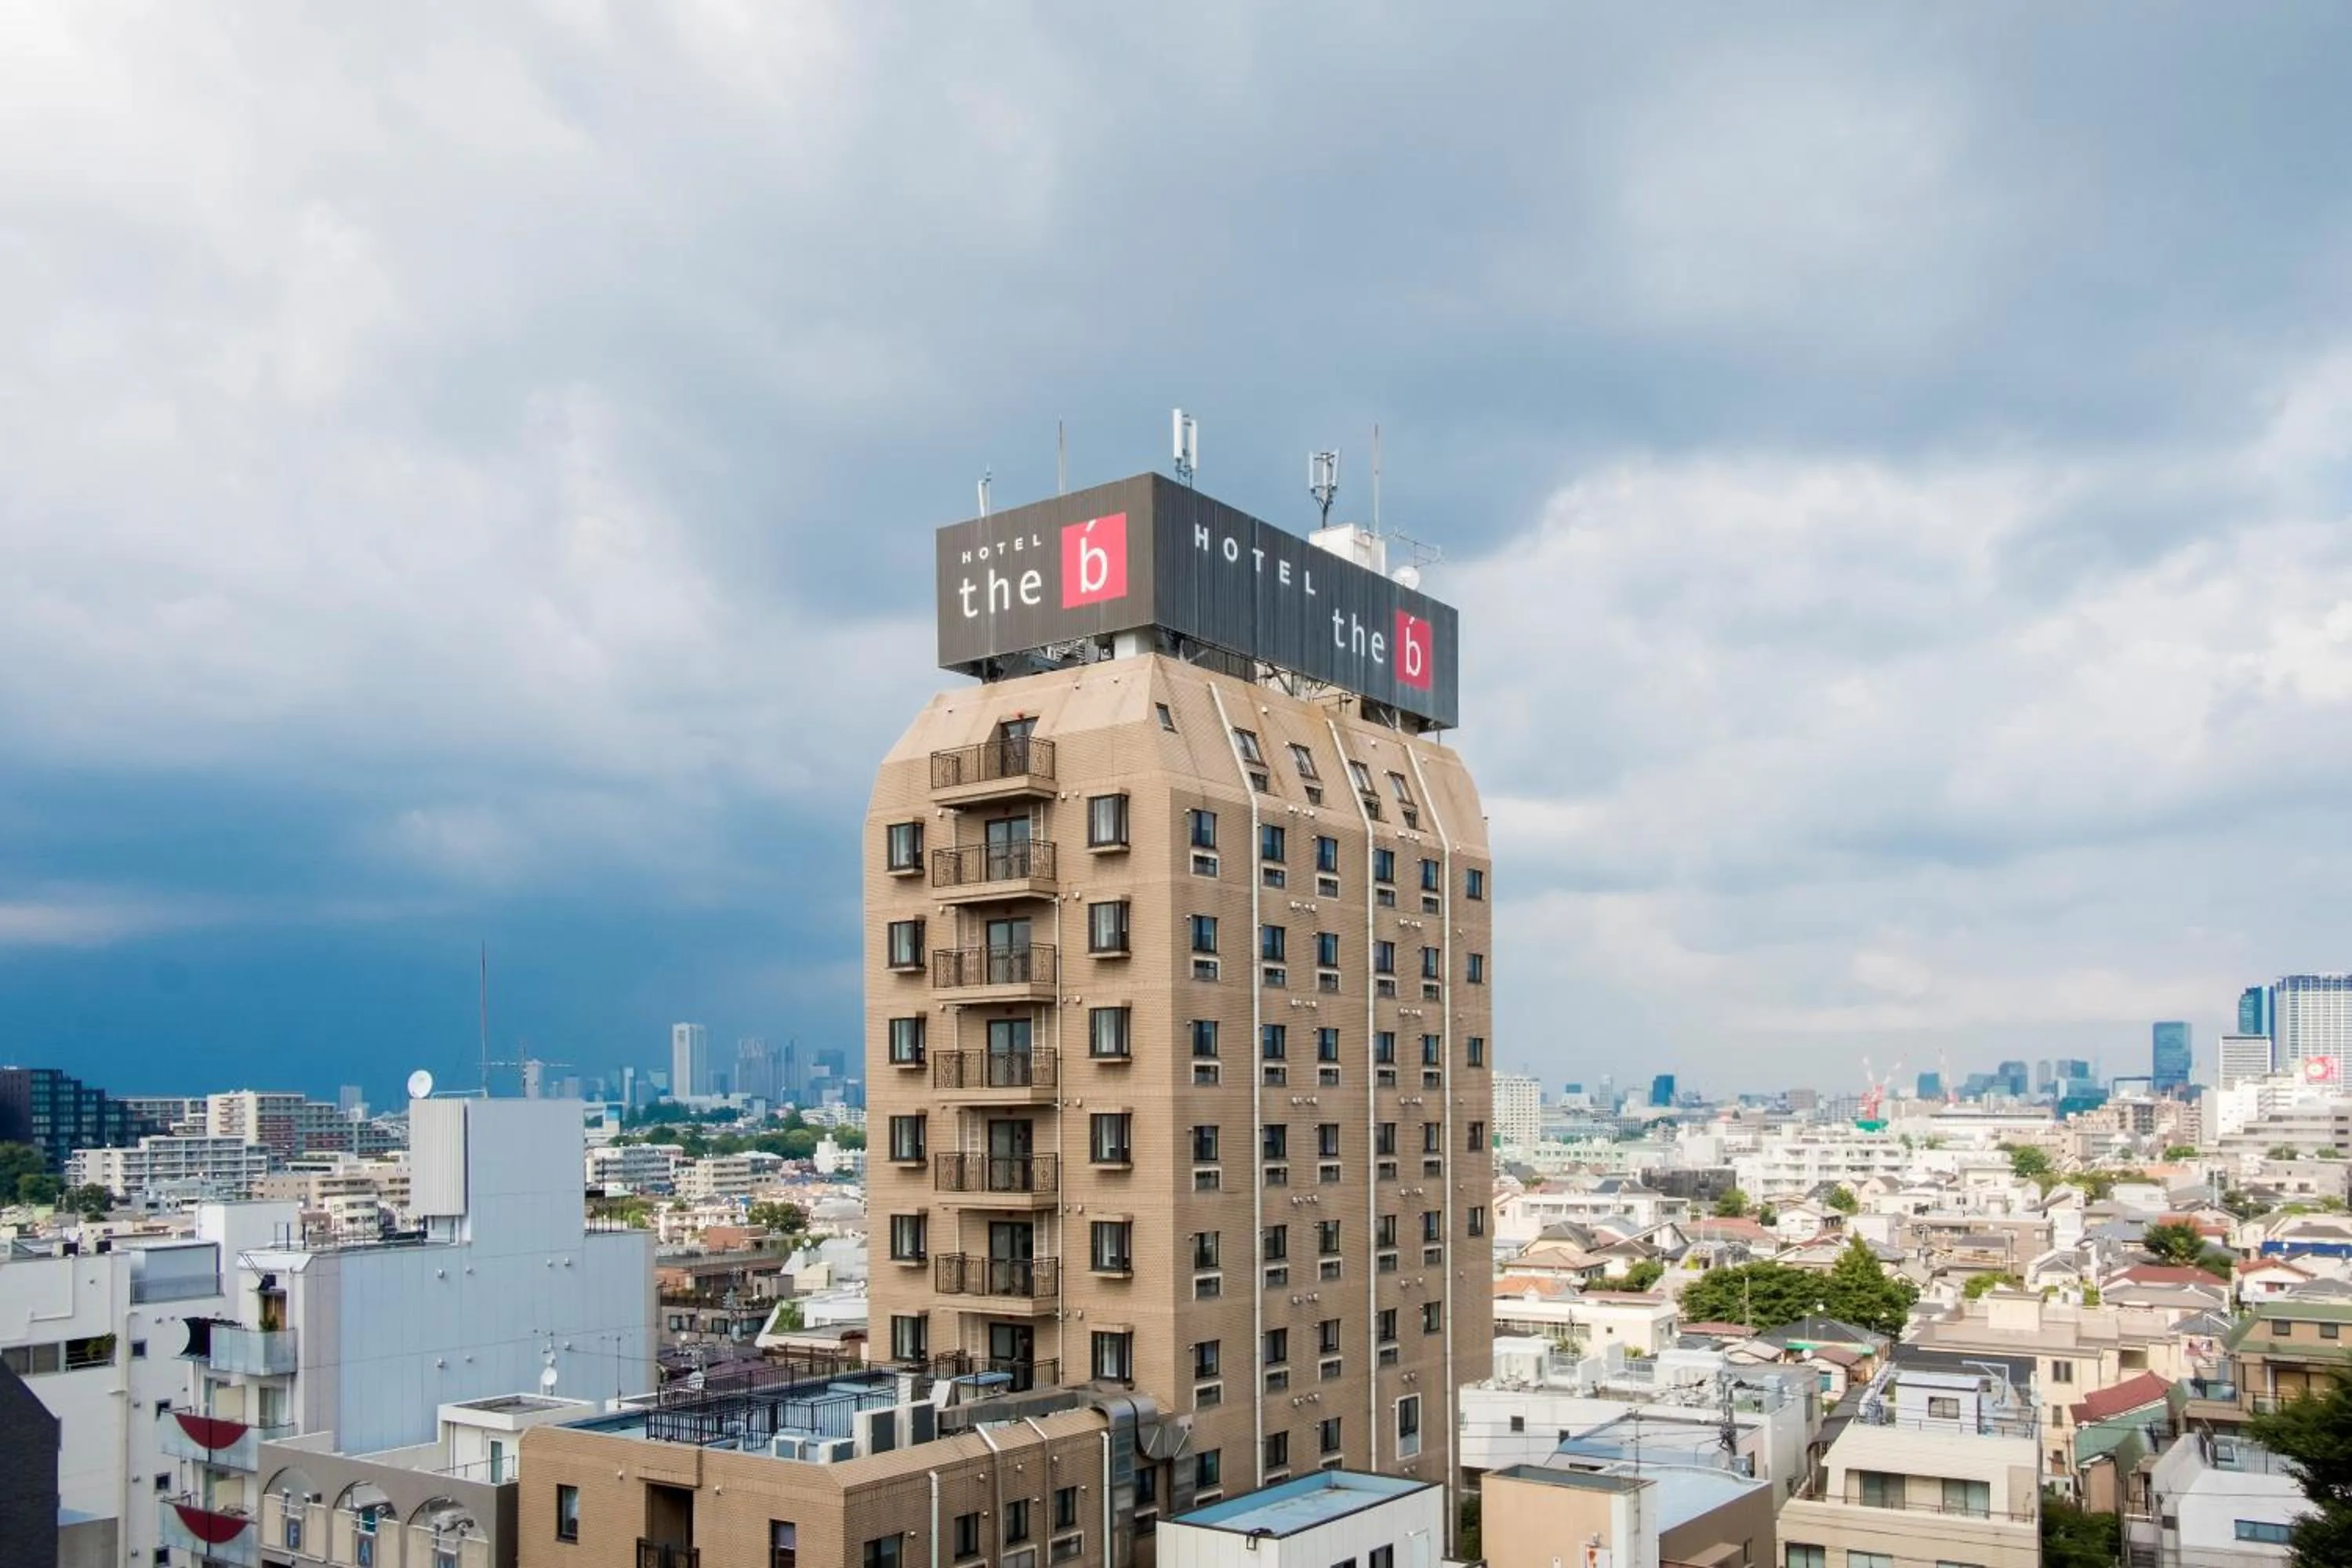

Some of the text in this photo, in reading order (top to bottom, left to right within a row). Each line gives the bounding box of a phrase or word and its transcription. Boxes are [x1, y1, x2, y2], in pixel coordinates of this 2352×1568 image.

[961, 534, 1042, 564] HOTEL
[959, 568, 1043, 619] the
[1194, 523, 1316, 596] HOTEL
[1332, 608, 1385, 664] the
